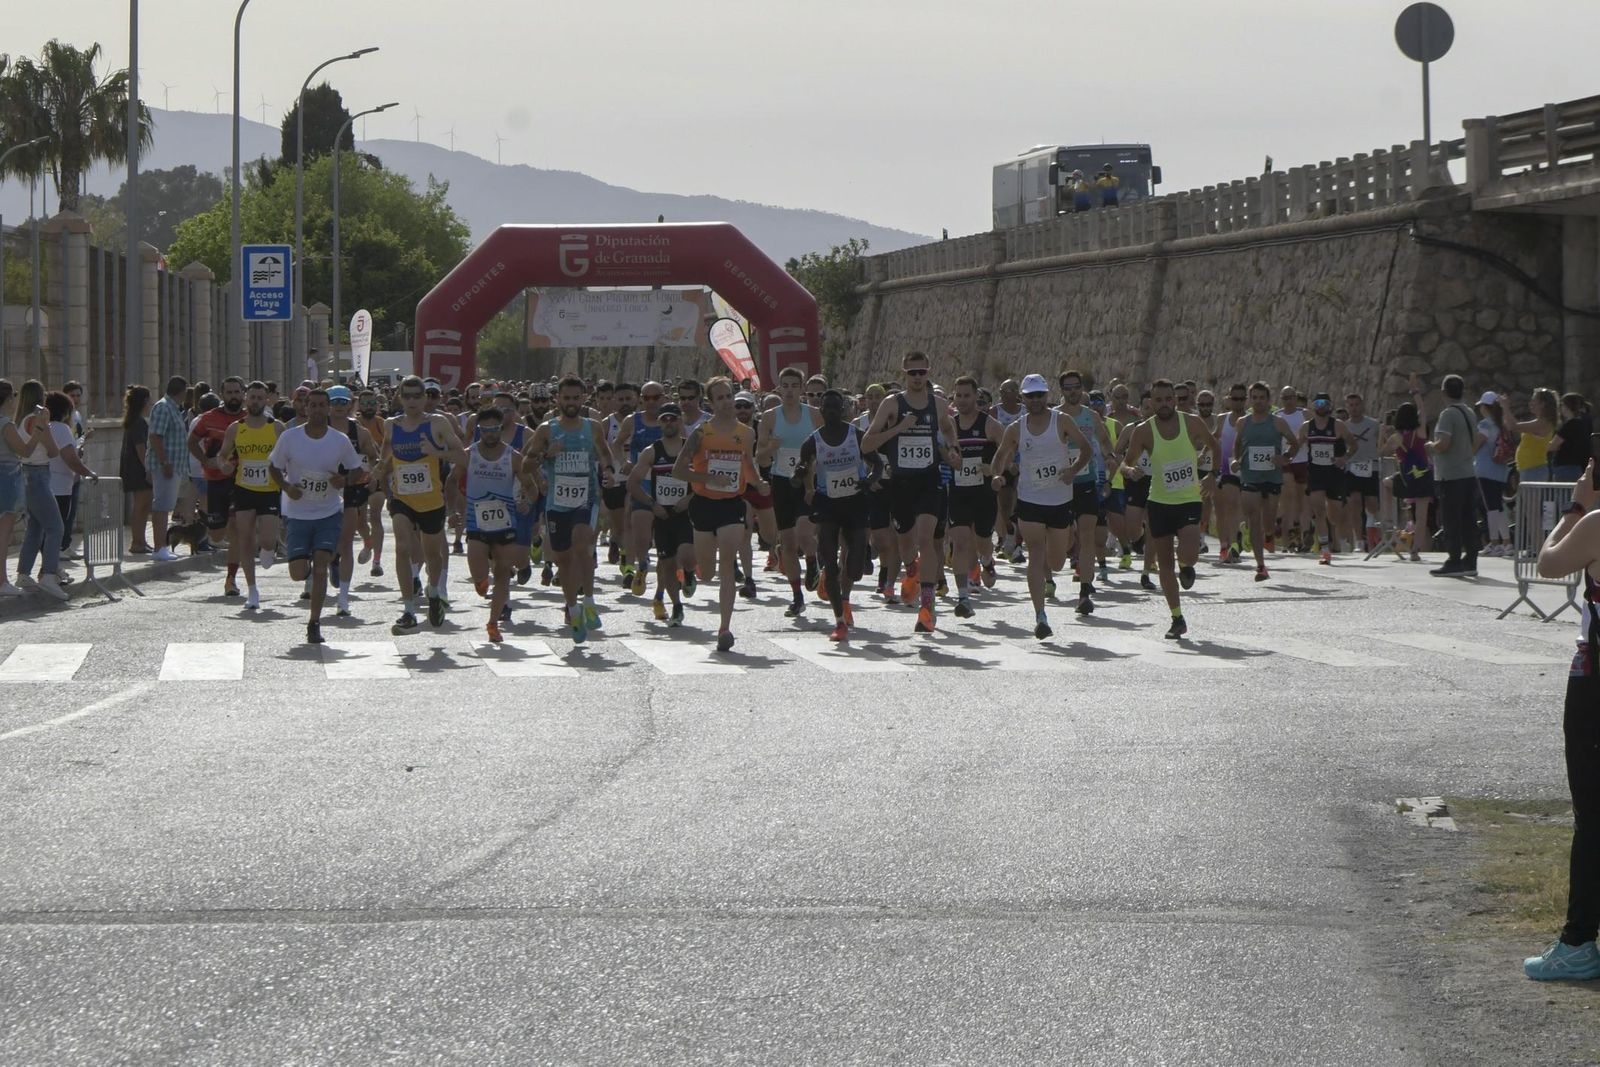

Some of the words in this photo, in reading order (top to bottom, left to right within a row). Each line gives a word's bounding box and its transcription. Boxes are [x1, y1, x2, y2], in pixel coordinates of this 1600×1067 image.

[595, 234, 670, 248] Diputación
[594, 249, 611, 264] de
[613, 250, 671, 264] Granada
[451, 262, 506, 312] DEPORTES
[724, 259, 778, 310] DEPORTES
[249, 291, 284, 299] Acceso
[253, 300, 280, 309] Playa
[901, 447, 931, 459] 3136
[1253, 454, 1271, 462] 524
[243, 467, 267, 478] 3011
[403, 472, 425, 484] 598
[1035, 465, 1057, 479] 139
[1164, 466, 1193, 484] 3089
[301, 479, 328, 492] 3189
[831, 477, 854, 490] 740
[556, 485, 586, 498] 3197
[657, 485, 685, 497] 3099
[481, 509, 504, 521] 670
